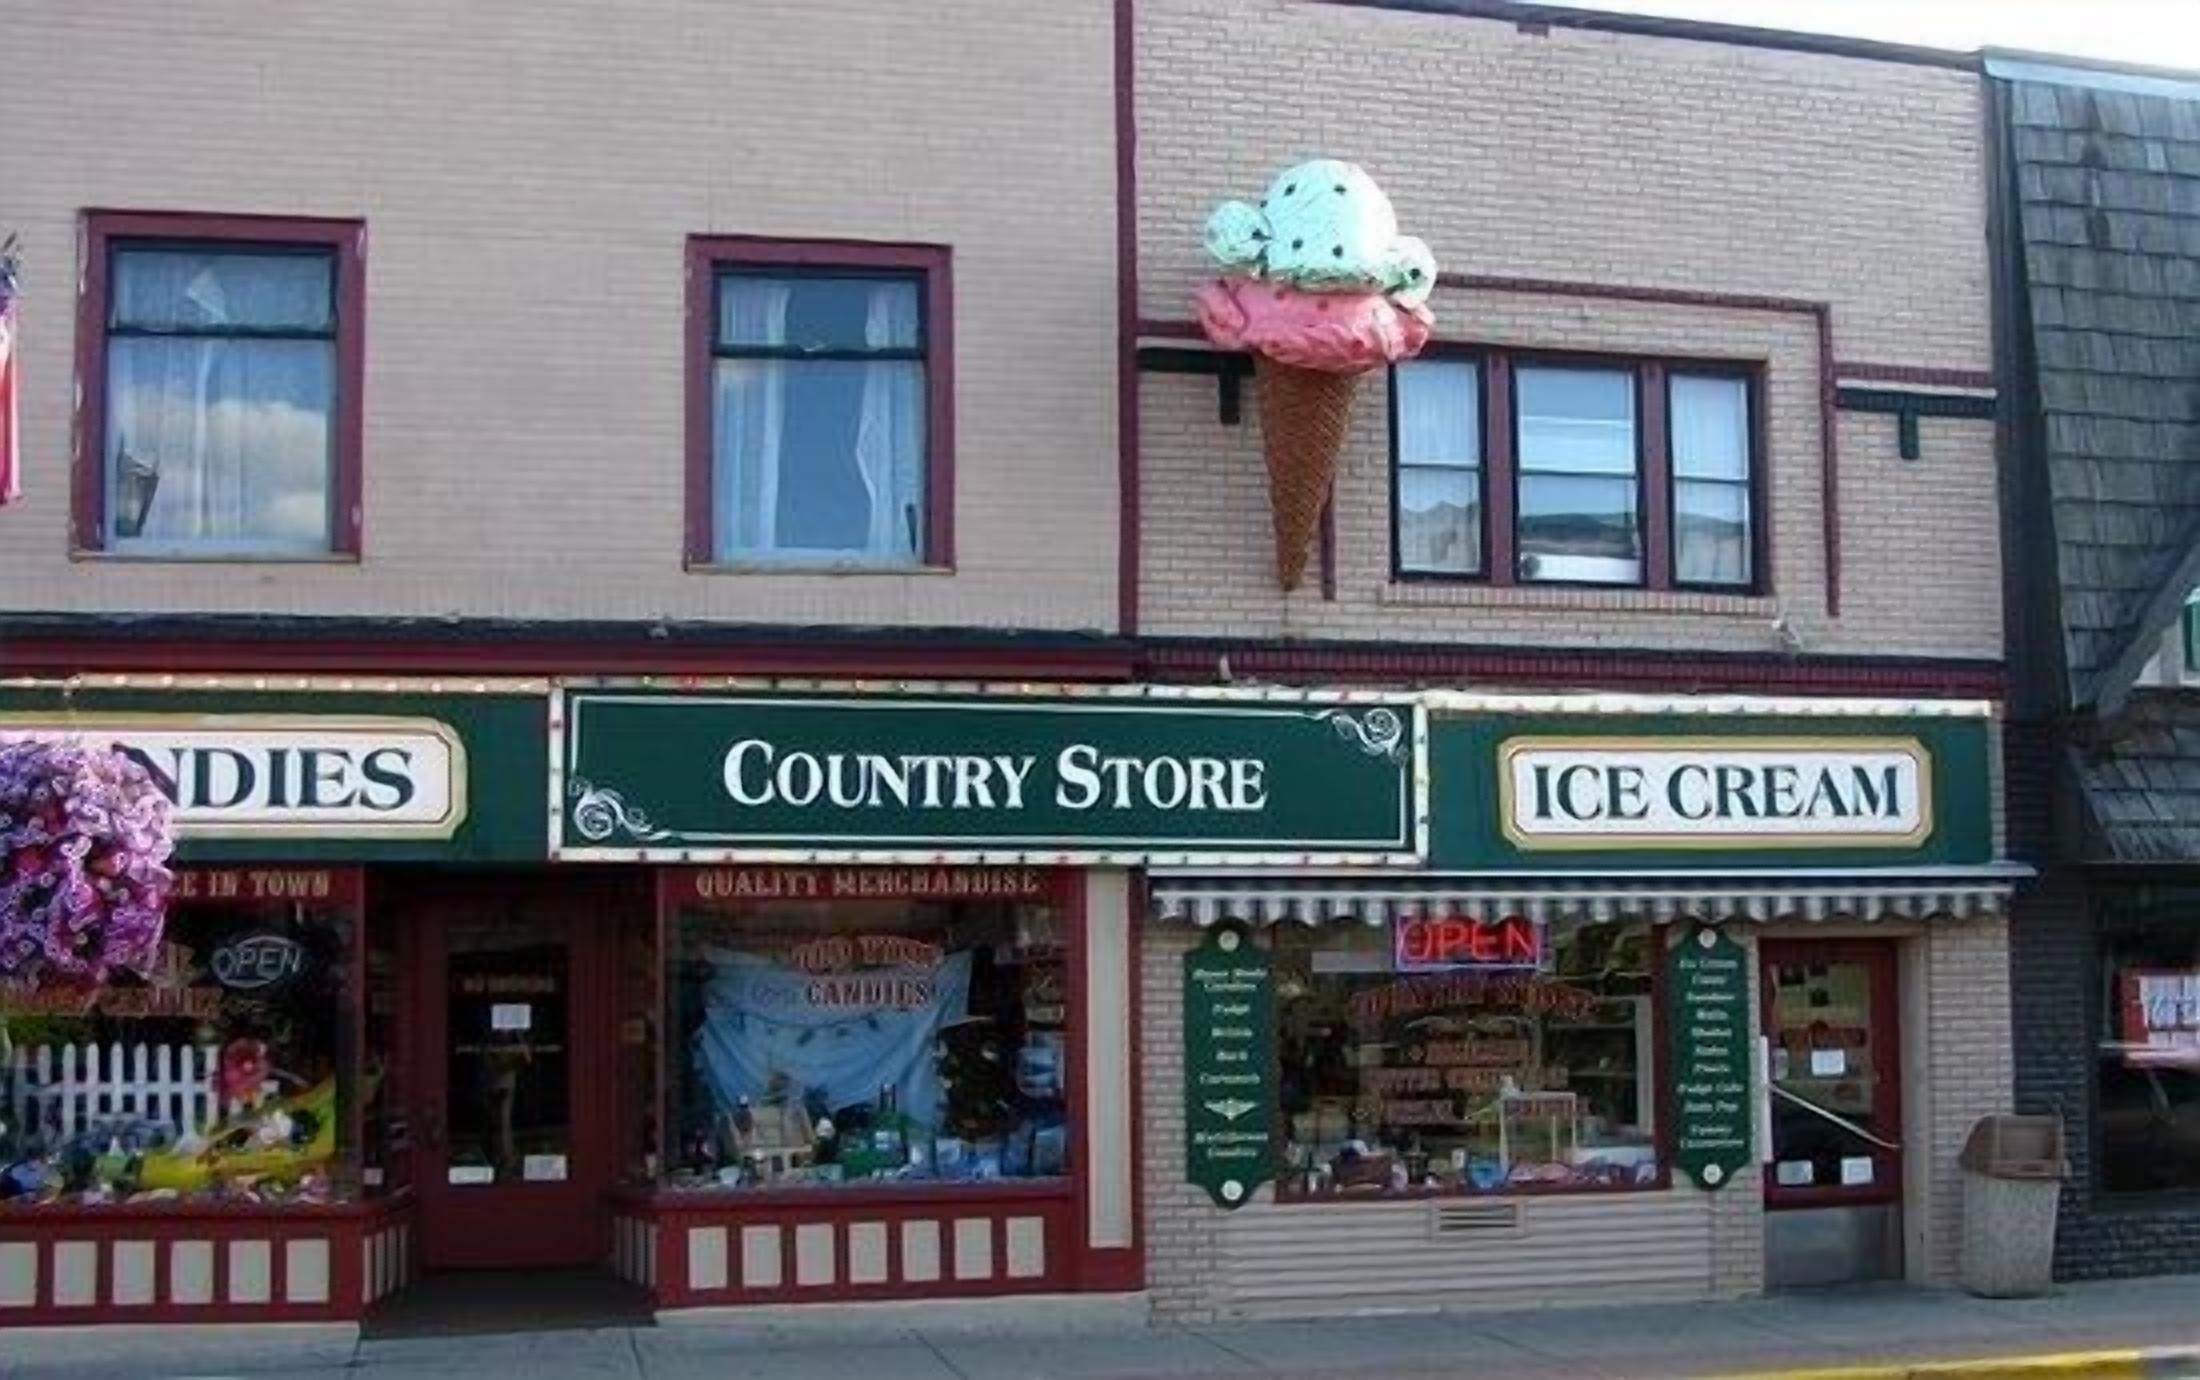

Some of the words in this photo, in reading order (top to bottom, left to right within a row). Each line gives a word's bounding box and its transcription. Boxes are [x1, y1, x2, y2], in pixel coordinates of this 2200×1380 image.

[723, 739, 1035, 808] COUNTRY
[1056, 744, 1268, 809] STORE
[1534, 765, 1650, 820] ICE
[1667, 764, 1899, 820] CREAM
[209, 871, 237, 897] IN
[250, 871, 330, 897] TOWN
[695, 871, 818, 898] QUALITY
[831, 868, 1040, 896] MERCHANDISE
[1398, 918, 1538, 961] OPEN
[211, 943, 303, 978] OPEN
